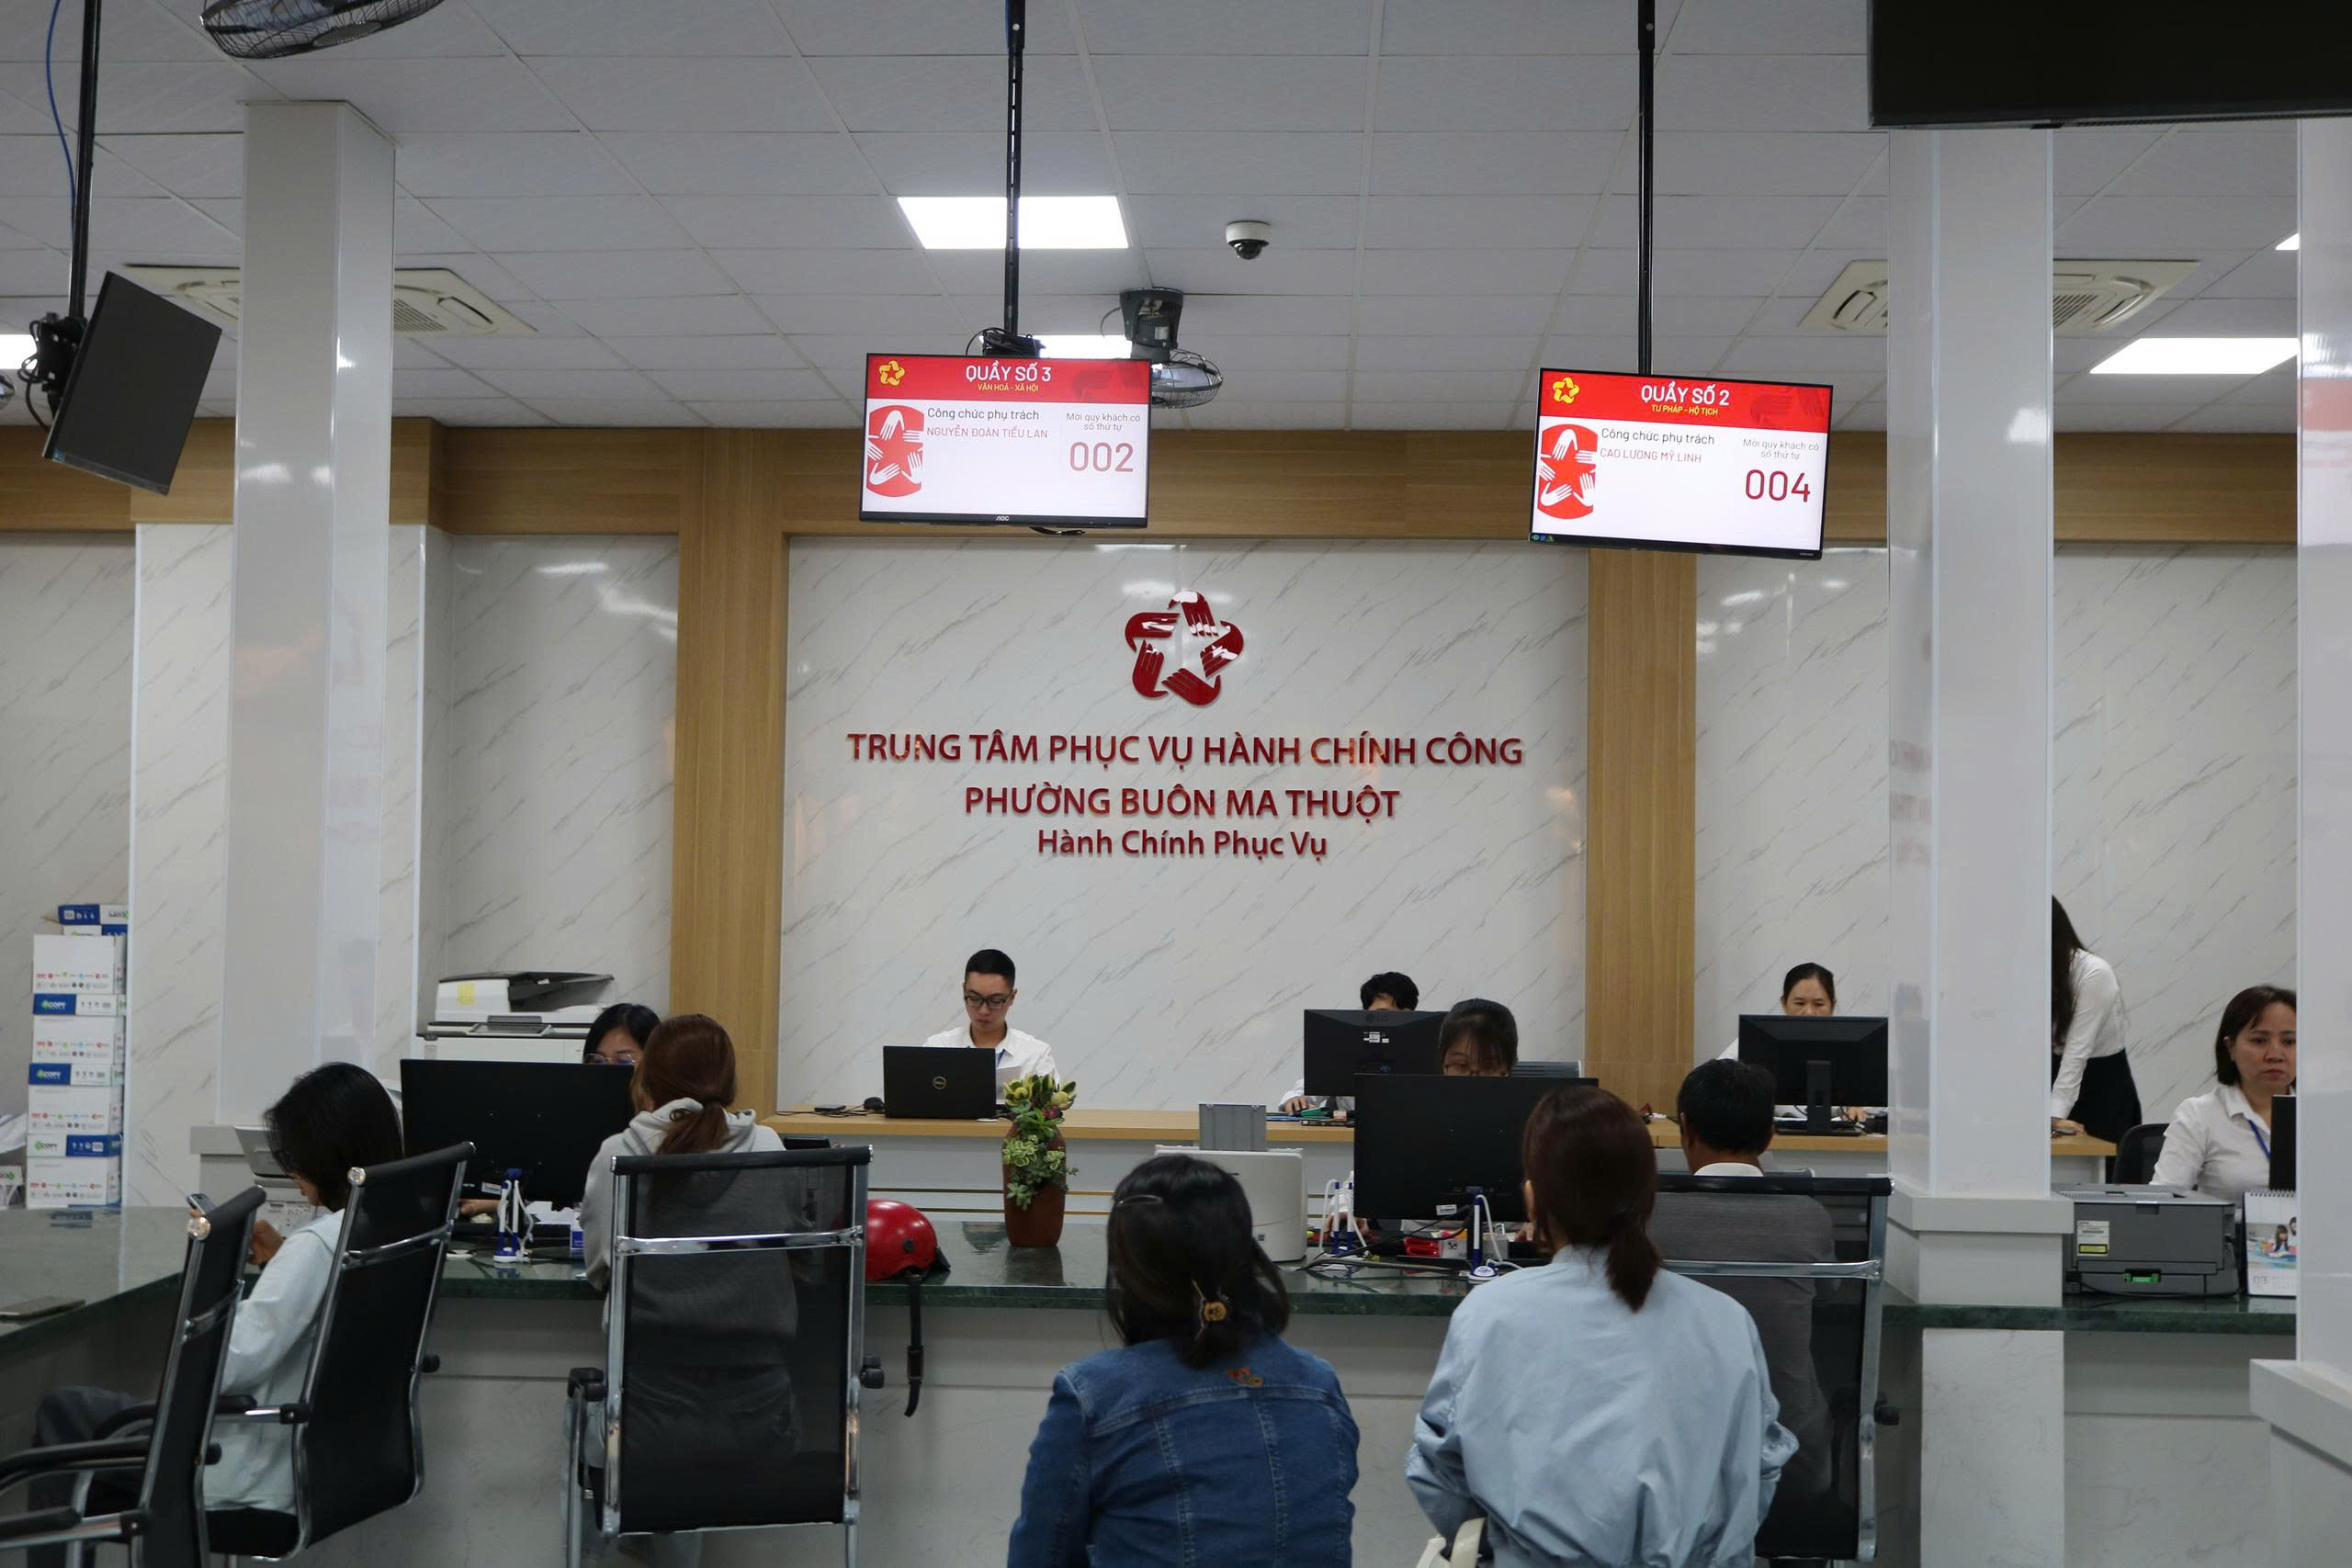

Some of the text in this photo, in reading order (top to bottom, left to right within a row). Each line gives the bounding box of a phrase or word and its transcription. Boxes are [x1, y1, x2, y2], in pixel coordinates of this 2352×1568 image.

[966, 360, 1052, 382] QUẦY SỐ 3
[1641, 380, 1730, 406] QUẦY SỐ 2
[927, 407, 1039, 421] Công chức phụ trách
[1027, 429, 1048, 438] LAN
[1601, 428, 1714, 445] Công chức phụ trách
[1070, 441, 1134, 472] 002
[1600, 447, 1621, 458] CAO
[1677, 453, 1702, 463] LINH
[1746, 469, 1811, 502] 004
[847, 728, 1522, 770] TRUNG TÂM PHỤC VỤ HÀNH CHÍNH CÔNG
[966, 782, 1400, 824] PHƯỜNG BUÔN MA THUỘT
[1038, 829, 1327, 862] Hành Chính Phục Vụ
